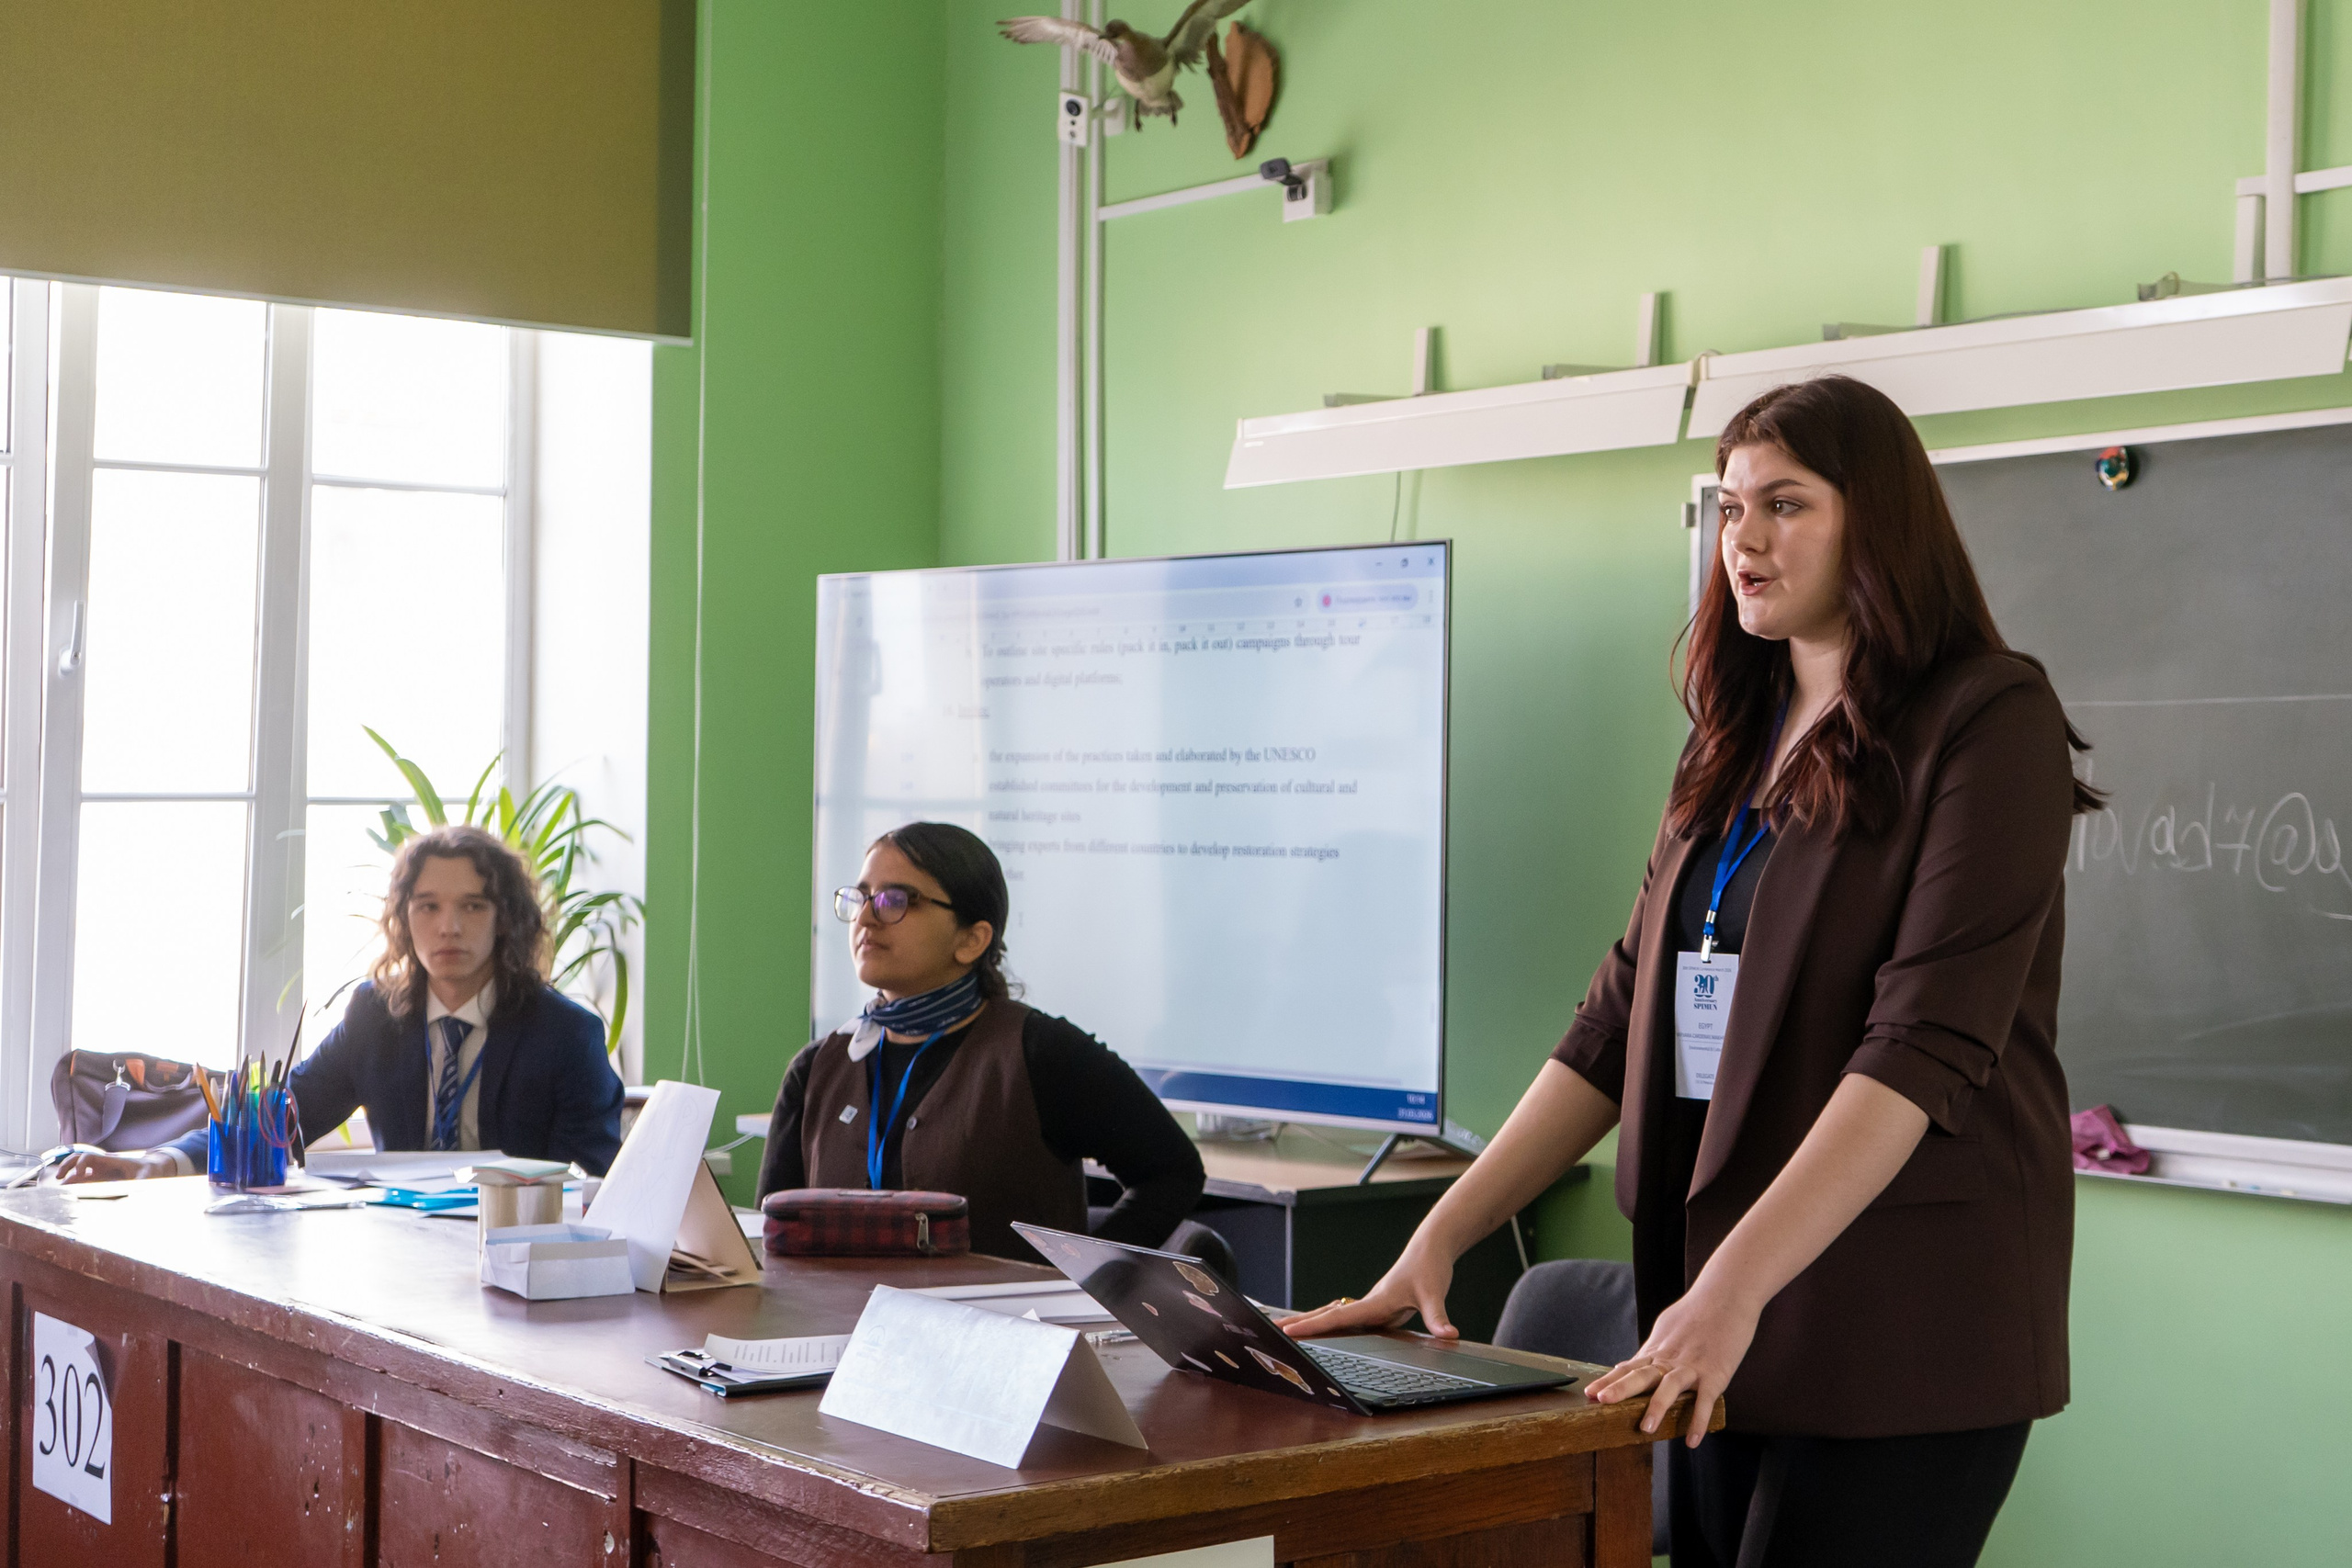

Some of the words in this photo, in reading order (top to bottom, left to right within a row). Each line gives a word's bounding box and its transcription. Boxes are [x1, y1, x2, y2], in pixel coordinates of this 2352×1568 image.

[1051, 639, 1087, 659] specific
[1091, 639, 1114, 654] rules
[1117, 638, 1144, 657] (pack
[1148, 638, 1156, 653] it
[1174, 637, 1198, 656] pack
[1201, 636, 1209, 651] it
[1211, 635, 1233, 652] out)
[1235, 635, 1291, 653] campaigns
[1294, 632, 1336, 651] through
[1339, 634, 1361, 647] tour
[1024, 671, 1041, 685] and
[1044, 671, 1073, 690] digital
[989, 748, 1002, 762] the
[1005, 750, 1051, 766] expansion
[1053, 748, 1064, 762] of
[1065, 748, 1080, 762] the
[1081, 749, 1124, 766] practices
[1125, 748, 1153, 762] taken
[1156, 748, 1173, 762] and
[1175, 747, 1227, 763] elaborated
[1229, 747, 1242, 766] by
[1244, 748, 1261, 762] the
[1263, 746, 1317, 762] UNESCO
[1096, 777, 1110, 793] for
[1112, 778, 1126, 793] the
[1128, 778, 1192, 796] development
[1194, 778, 1213, 794] and
[1215, 780, 1278, 797] preservation
[1280, 778, 1294, 794] of
[1295, 779, 1335, 794] cultural
[1337, 779, 1358, 795] and
[989, 808, 1020, 822] natural
[1022, 807, 1058, 825] heritage
[1028, 840, 1060, 855] experts
[1063, 838, 1086, 853] from
[1088, 838, 1128, 854] different
[1130, 840, 1175, 855] countries
[1177, 841, 1188, 855] to
[1190, 840, 1230, 861] develop
[1232, 842, 1287, 858] restoration
[1290, 844, 1340, 863] strategies
[40, 1354, 106, 1480] 302
